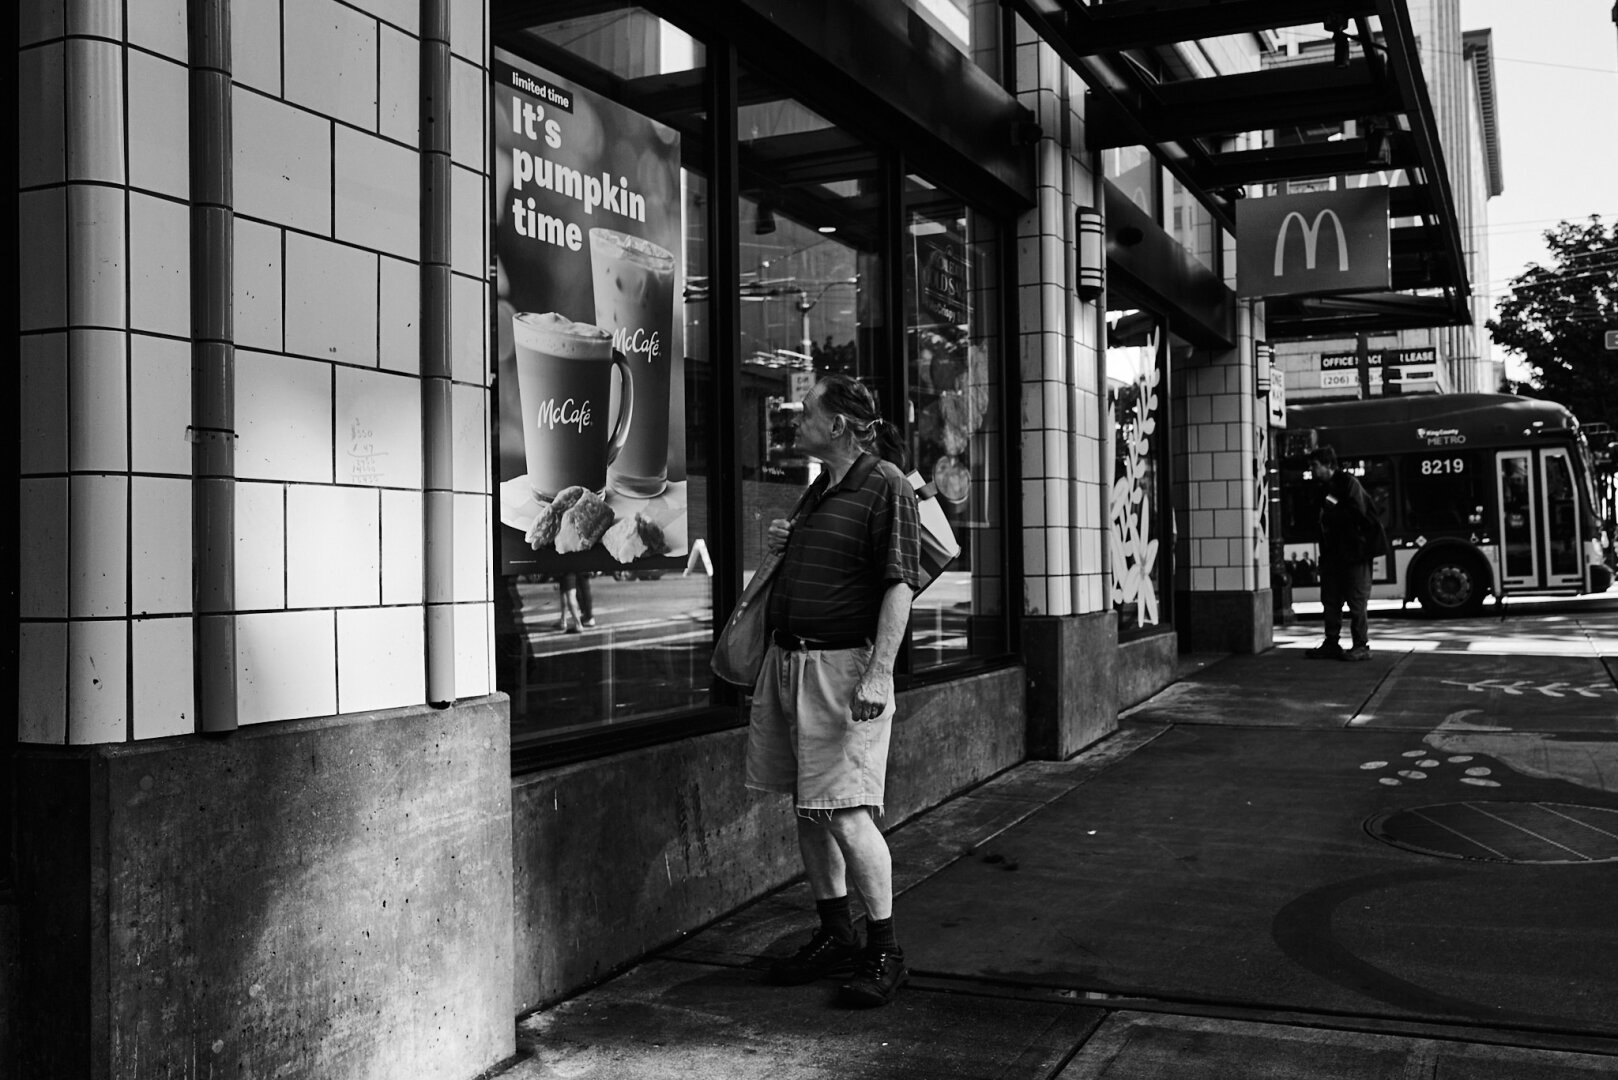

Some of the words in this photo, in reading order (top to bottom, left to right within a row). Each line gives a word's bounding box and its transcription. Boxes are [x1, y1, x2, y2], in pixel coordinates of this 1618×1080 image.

[512, 71, 546, 98] limited
[547, 88, 569, 108] time
[512, 96, 562, 149] It's
[512, 148, 646, 223] pumpkin
[512, 197, 583, 251] time
[612, 327, 660, 363] McCafé
[1322, 356, 1354, 368] OFFICE
[1405, 351, 1434, 362] LEASE
[1323, 375, 1350, 386] (206)
[537, 398, 592, 434] McCafé
[1427, 434, 1466, 446] METRO
[1421, 458, 1464, 475] 8219
